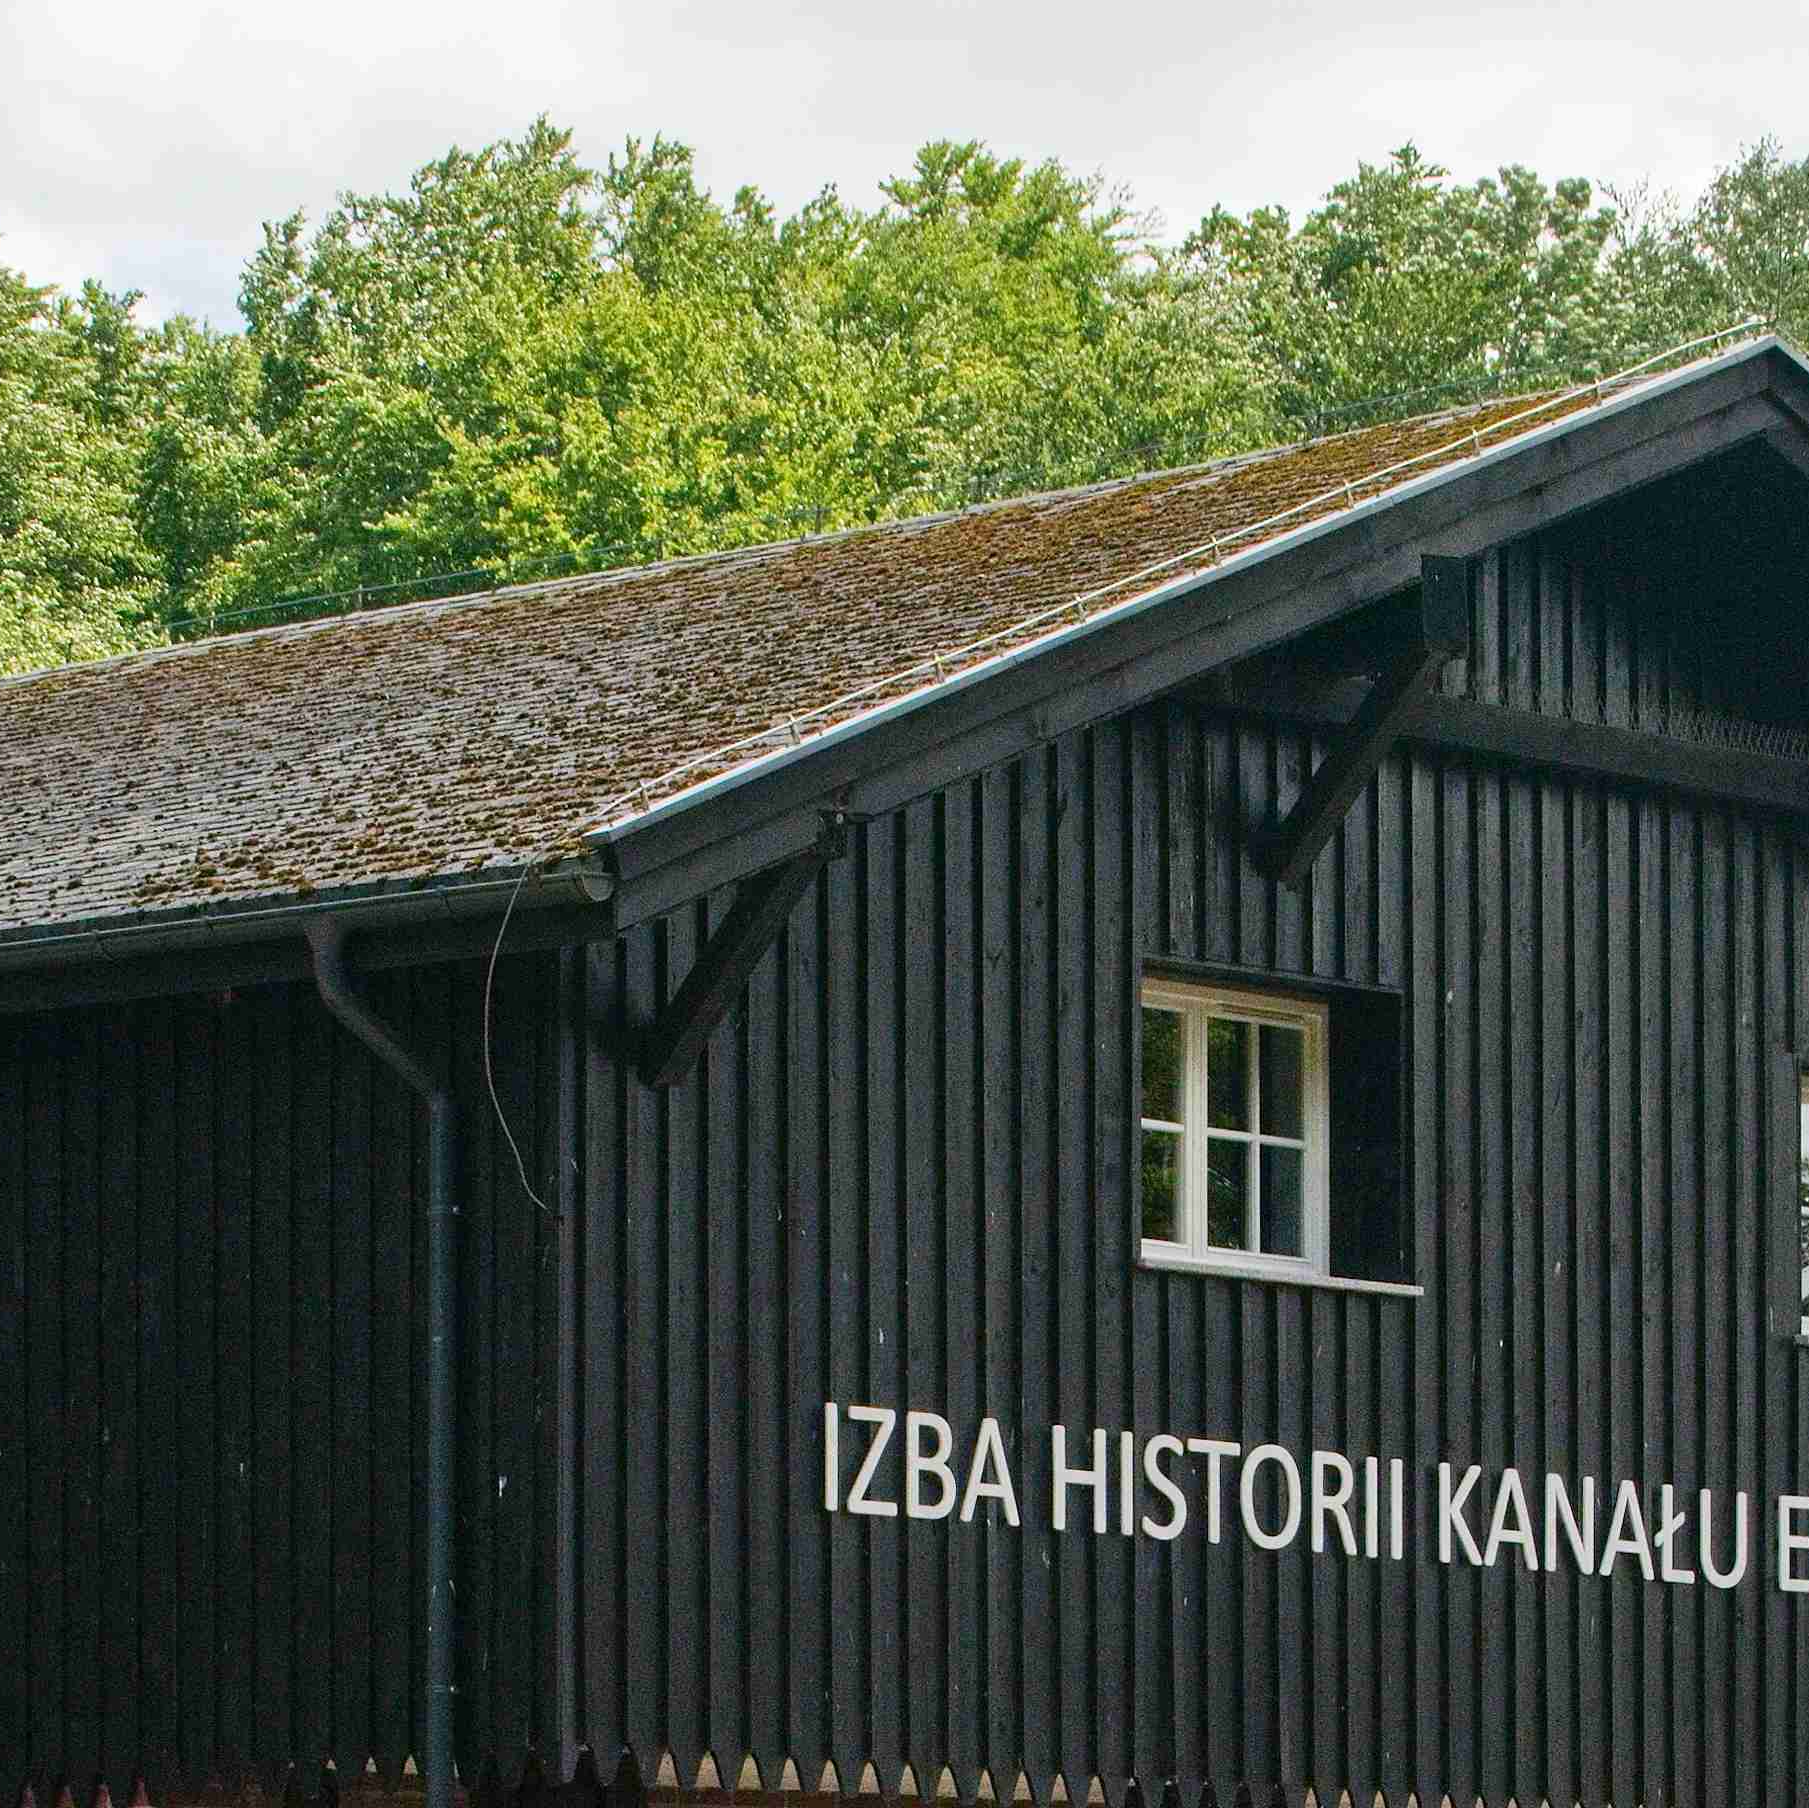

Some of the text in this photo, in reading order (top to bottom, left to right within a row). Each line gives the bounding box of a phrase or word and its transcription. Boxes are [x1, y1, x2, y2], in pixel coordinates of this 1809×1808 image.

[824, 1402, 1020, 1526] IZBA
[1052, 1425, 1403, 1560] HISTORII
[1438, 1462, 1747, 1588] KANAŁU
